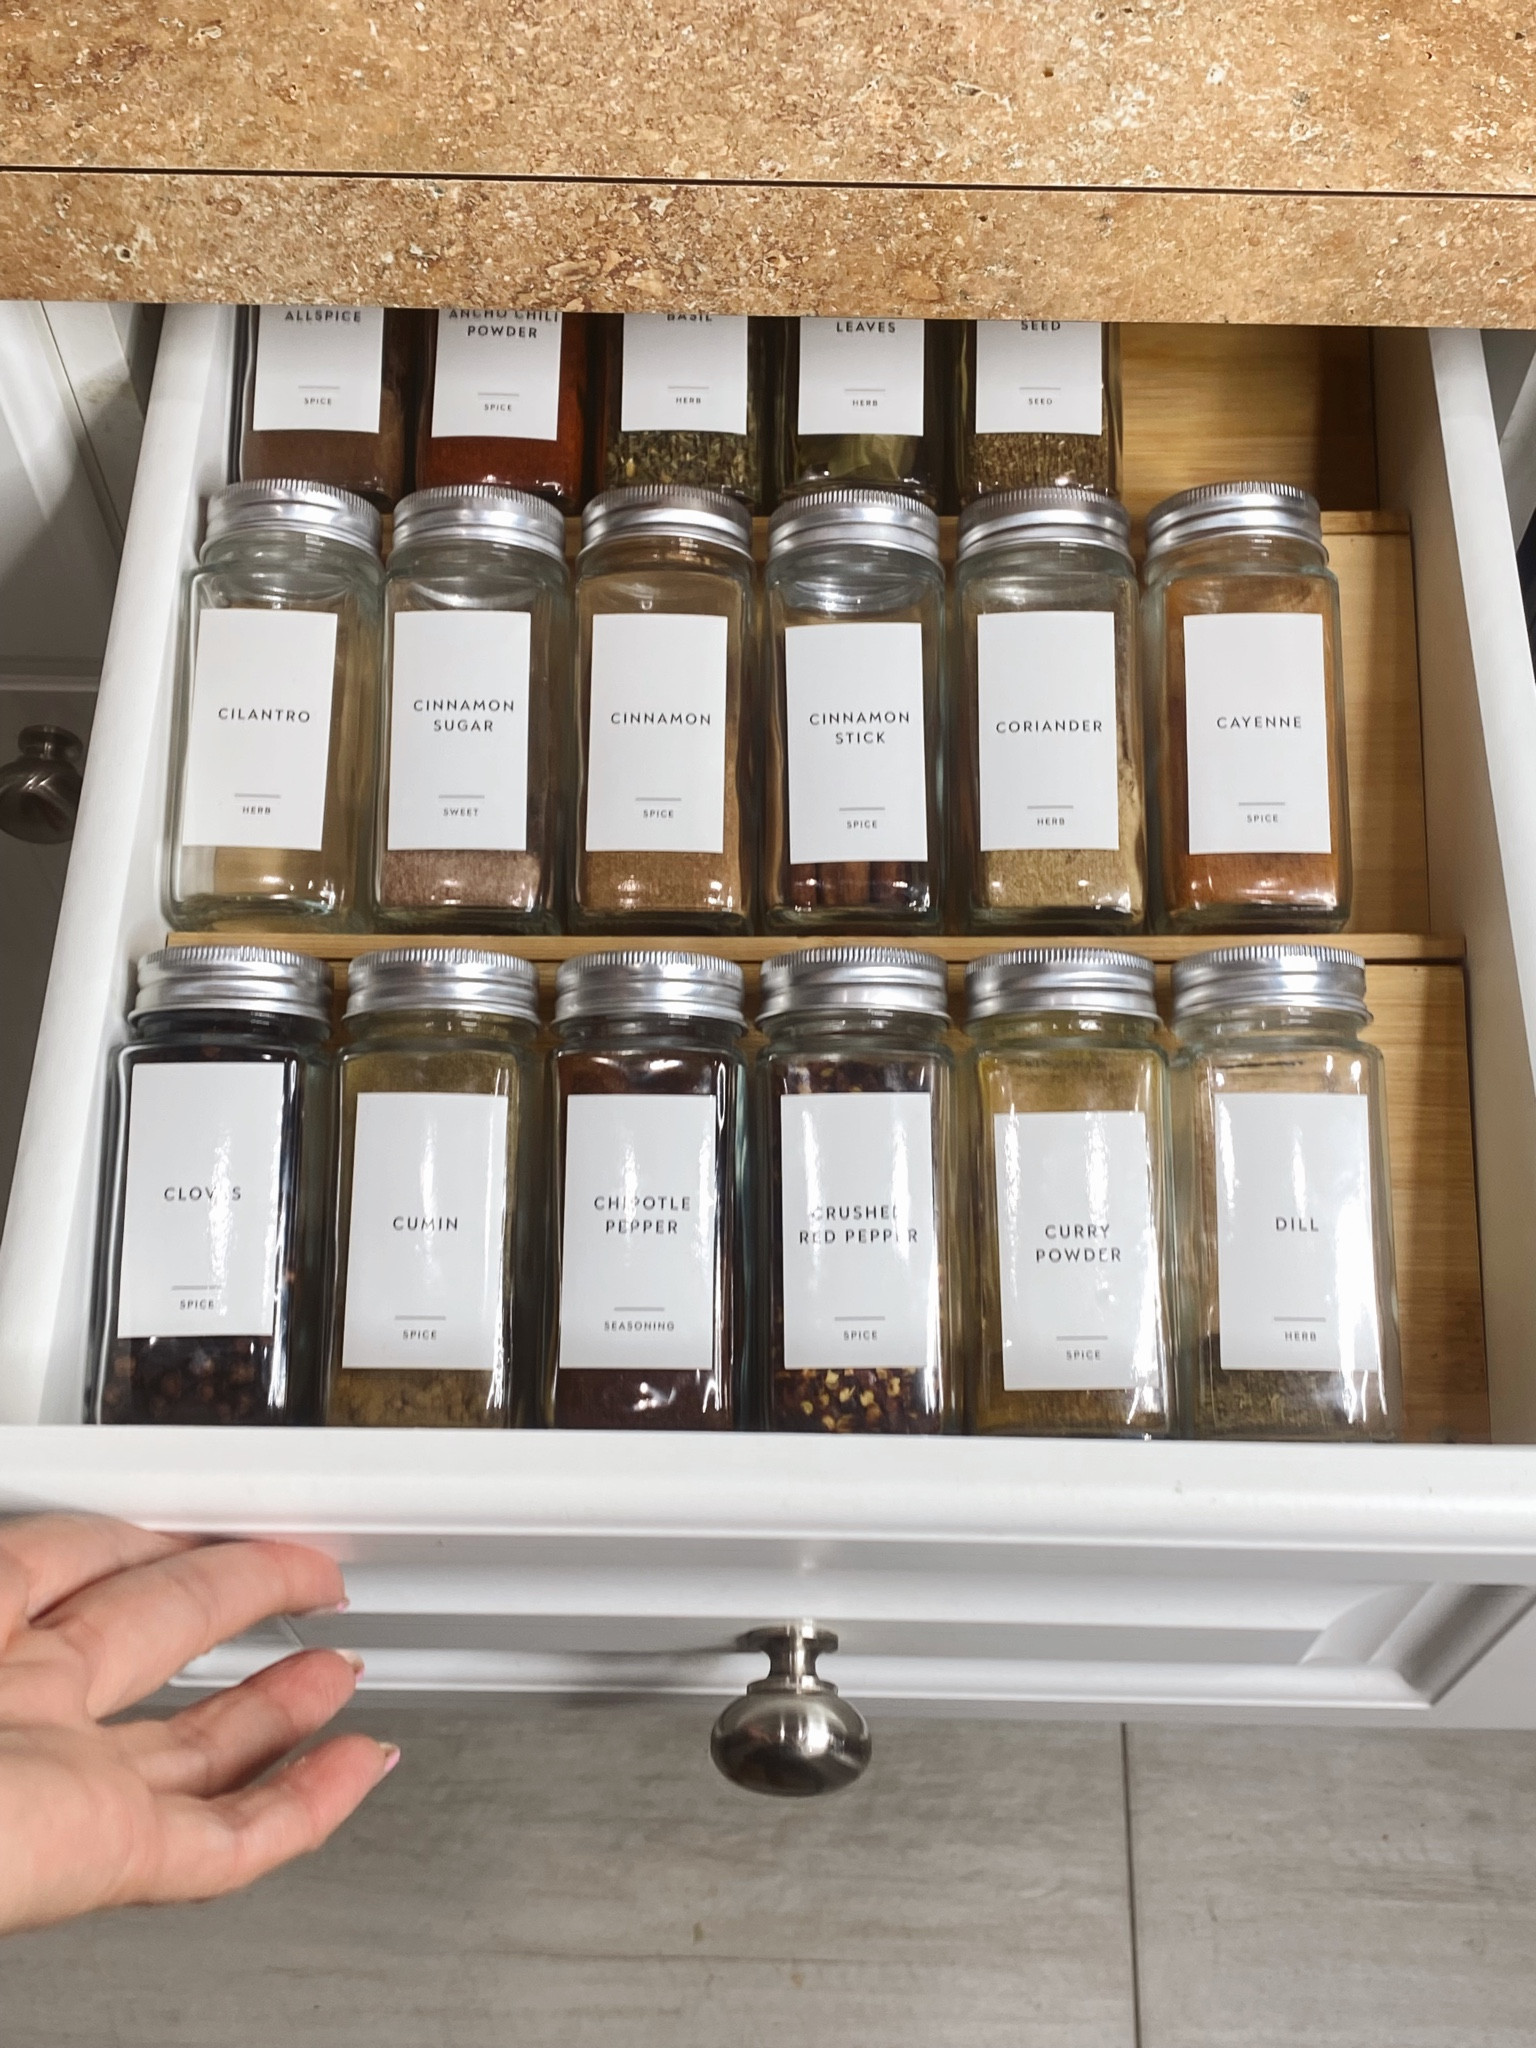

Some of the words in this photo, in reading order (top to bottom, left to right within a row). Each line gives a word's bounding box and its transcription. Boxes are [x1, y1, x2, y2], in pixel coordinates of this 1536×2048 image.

[284, 309, 361, 323] ALLSPICE
[467, 324, 538, 339] POWDER
[836, 320, 896, 334] LEAVES
[1020, 320, 1061, 332] SEED
[304, 397, 332, 406] SPICE
[675, 396, 702, 405] HERB
[852, 399, 878, 407] HERB
[1028, 397, 1053, 406] SEED
[484, 403, 512, 412] SPICE
[413, 699, 514, 712] CINNAMON
[218, 707, 311, 723] CILANTRO
[610, 712, 711, 726] CINNAMON
[809, 711, 910, 726] CINNAMON
[433, 719, 493, 732] SUGAR
[995, 719, 1102, 734] CORIANDER
[1216, 716, 1302, 729] CAYENNE
[835, 731, 885, 745] STICK
[242, 805, 271, 815] HERB
[443, 807, 478, 817] SWEET
[643, 809, 674, 819] SPICE
[846, 819, 877, 830] SPICE
[1036, 817, 1065, 826] HERB
[1246, 814, 1278, 824] SPICE
[163, 1186, 242, 1202] CLOVS
[392, 1216, 458, 1231] CUMIN
[605, 1219, 678, 1234] PEPPER
[1275, 1216, 1319, 1232] DILL
[845, 1228, 918, 1244] PEPPR
[1044, 1224, 1110, 1240] CURRY
[1035, 1247, 1121, 1263] POWDER
[180, 1299, 214, 1310] SPICE
[604, 1320, 675, 1332] SEASONING
[402, 1329, 437, 1340] SPICE
[843, 1330, 877, 1341] SPICE
[1284, 1331, 1317, 1342] HERB
[1066, 1349, 1100, 1361] SPICE
